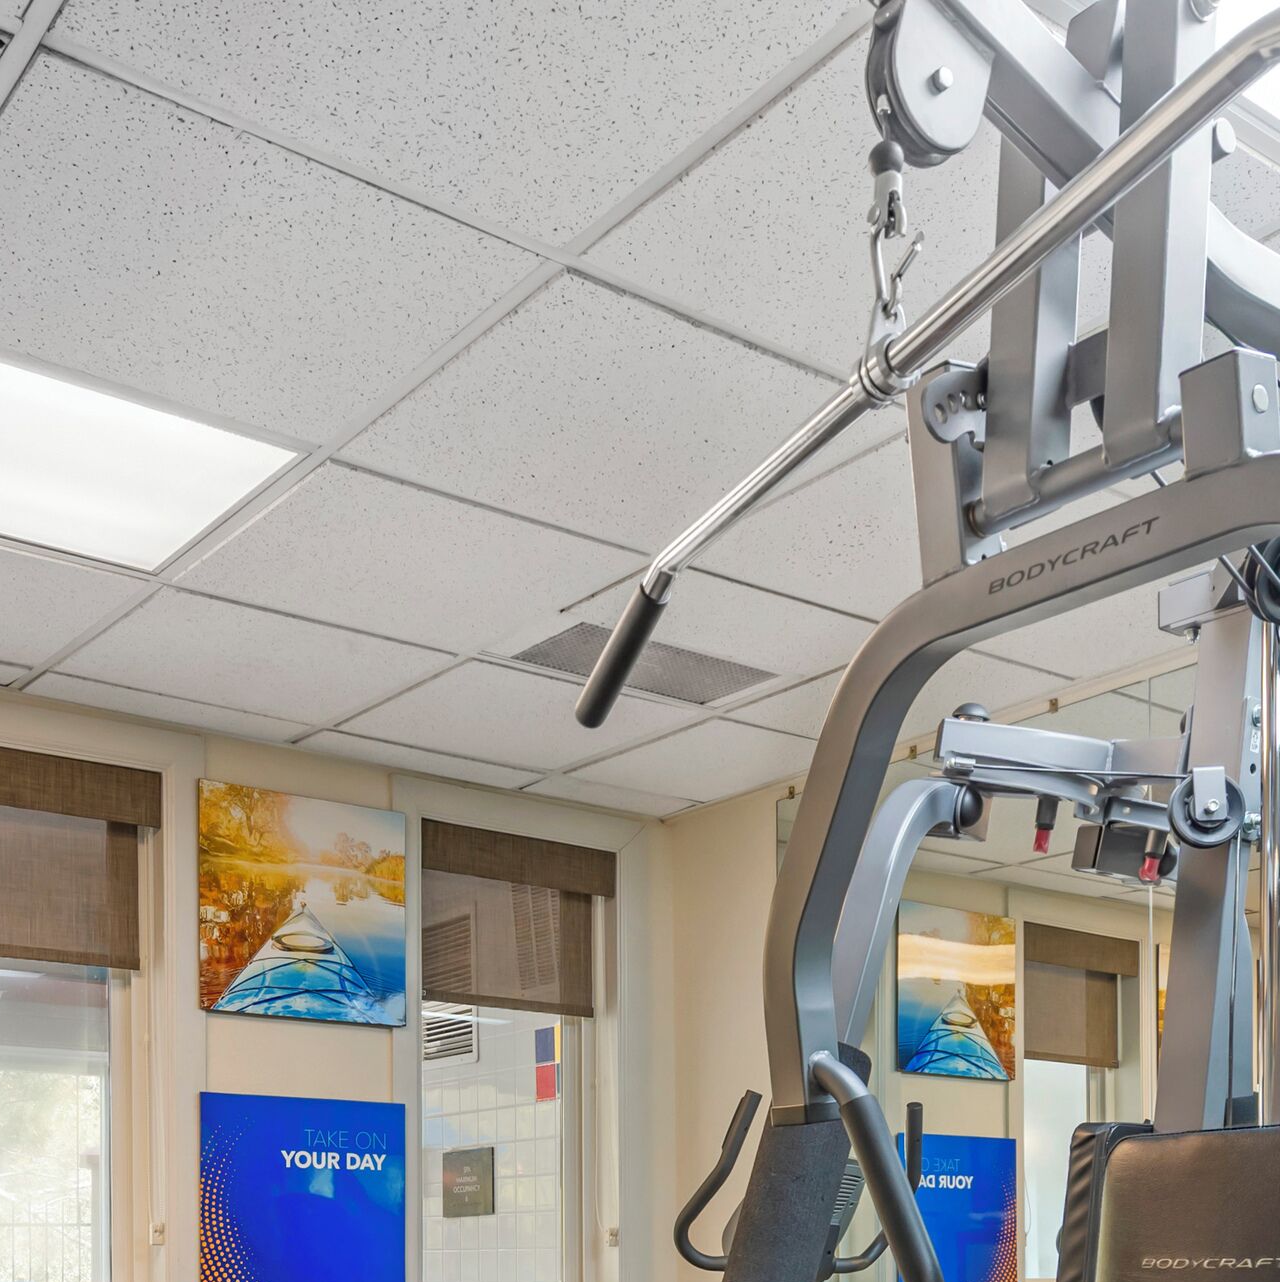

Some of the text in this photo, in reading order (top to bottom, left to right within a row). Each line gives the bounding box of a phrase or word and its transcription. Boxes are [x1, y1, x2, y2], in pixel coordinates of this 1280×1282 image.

[988, 516, 1160, 595] BODYCRAFT
[304, 1128, 387, 1150] TAKE ON
[281, 1150, 386, 1171] YOUR DAY
